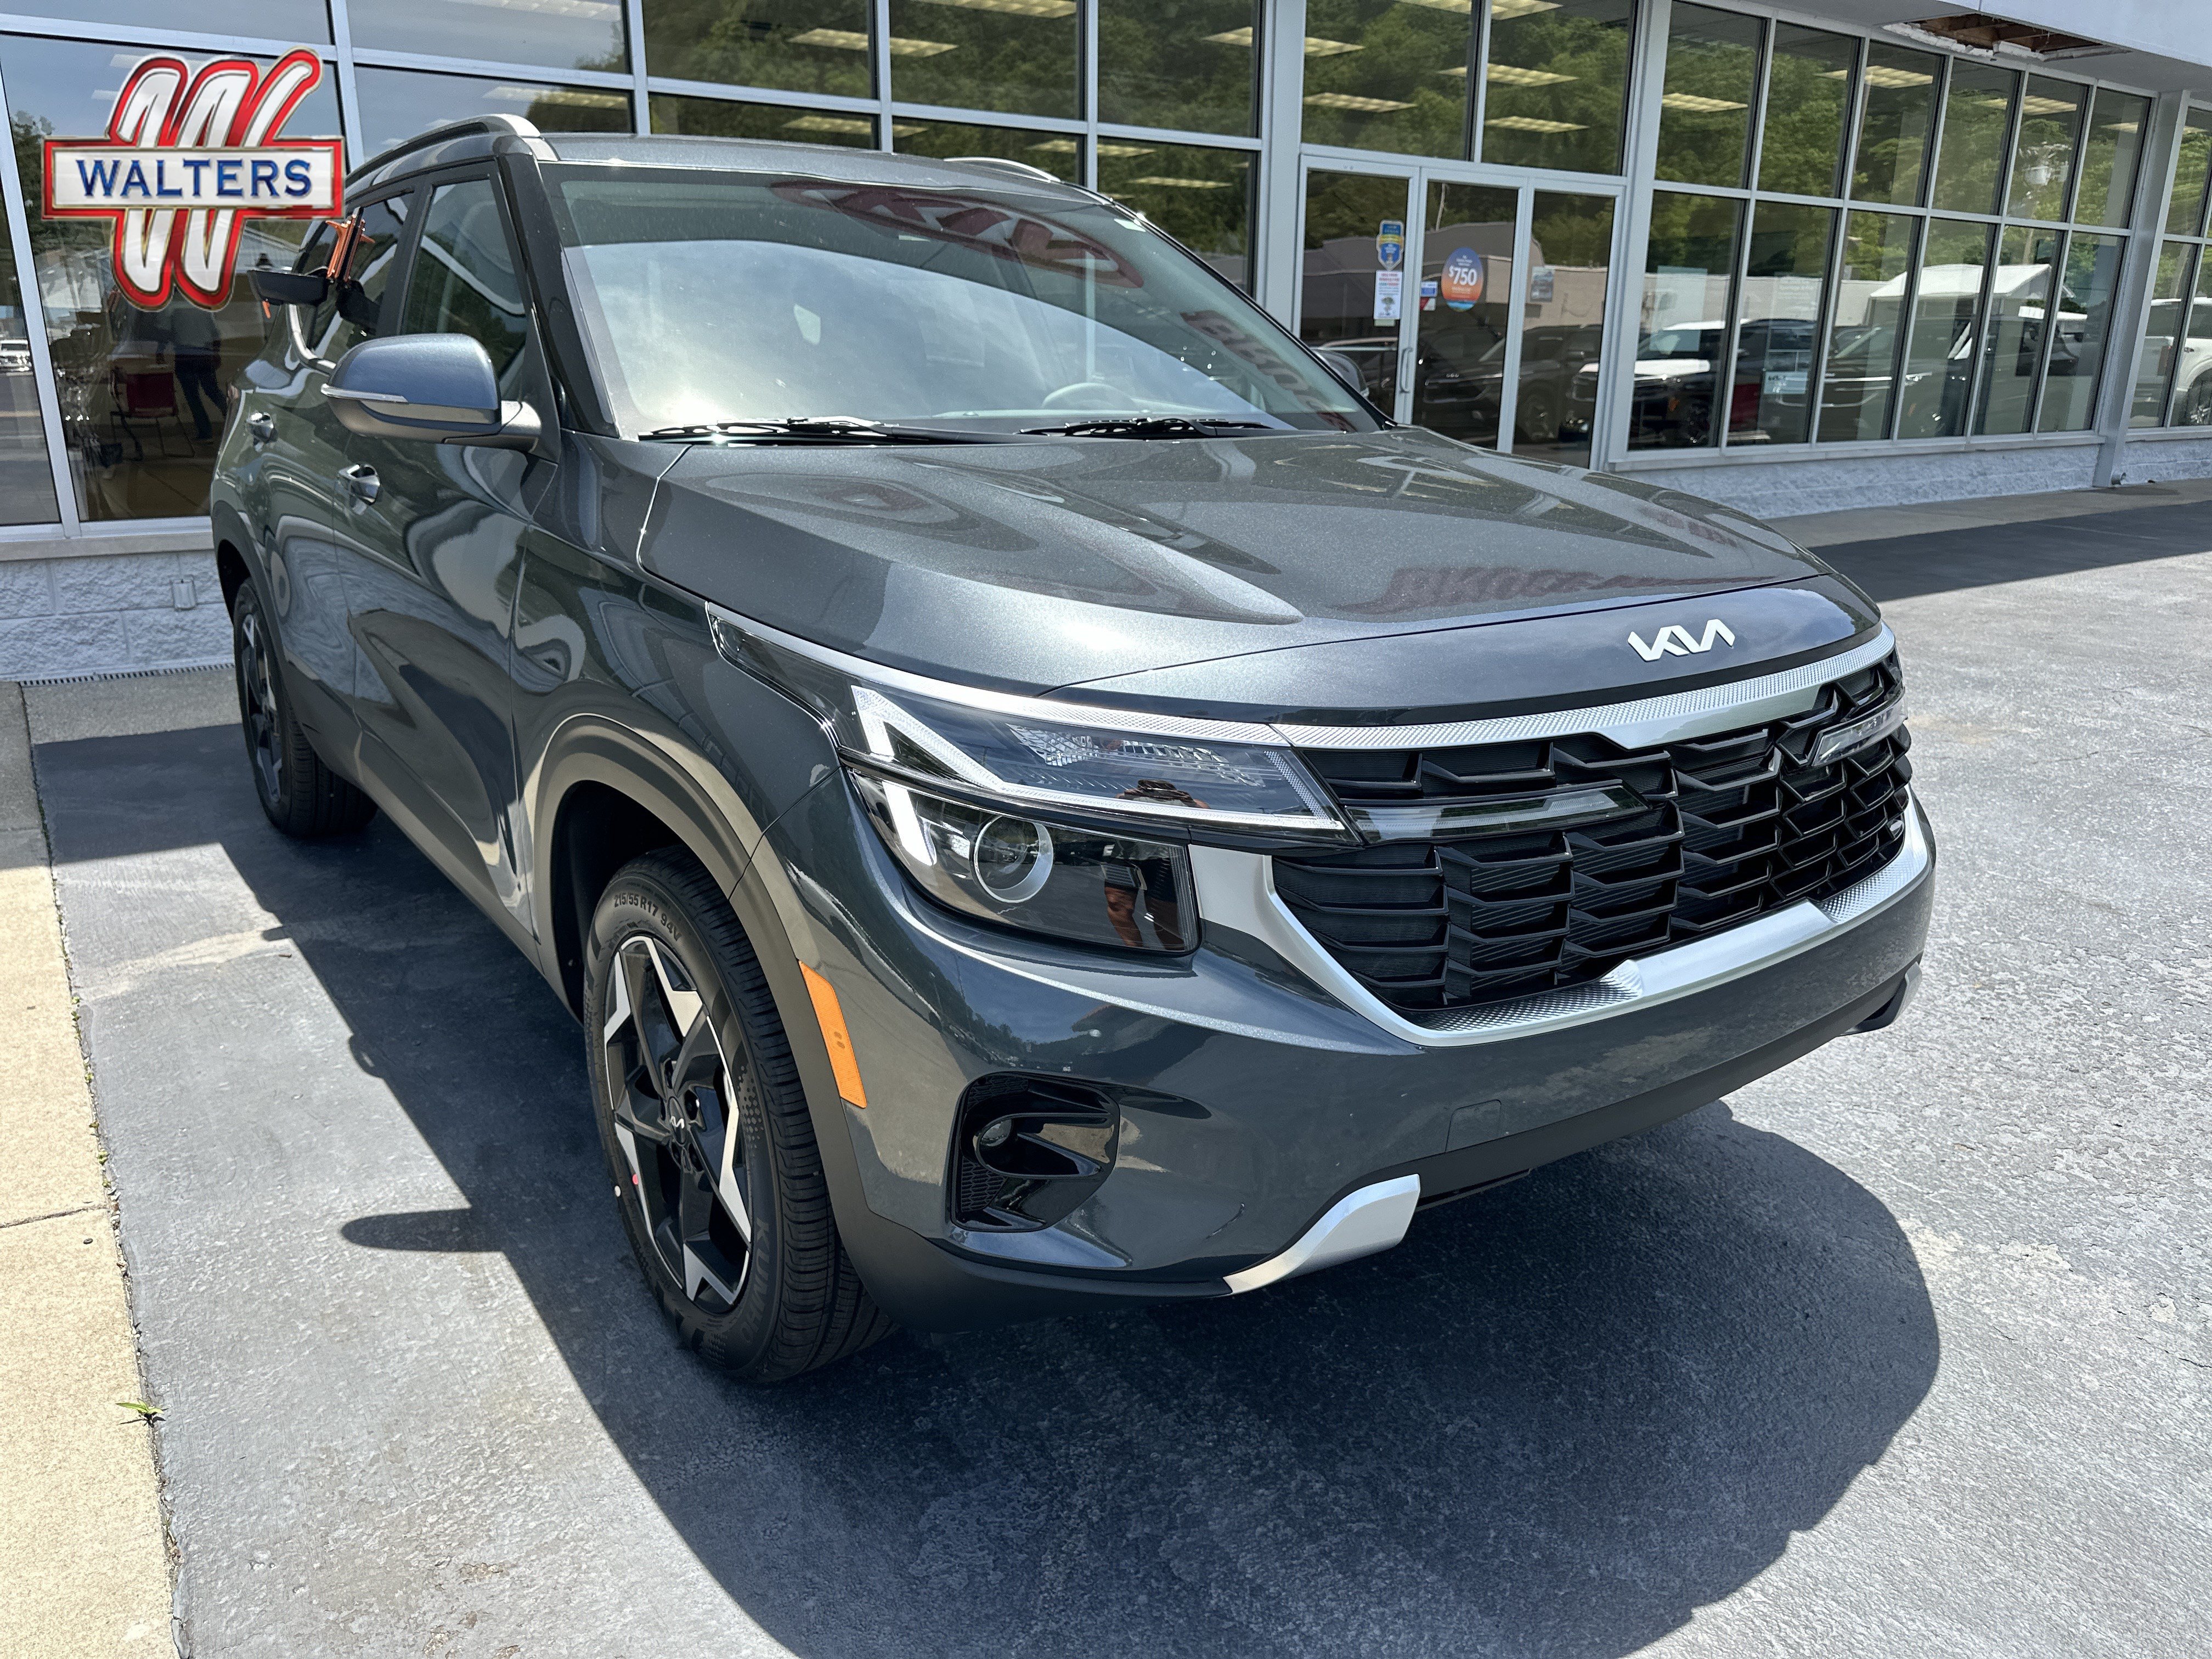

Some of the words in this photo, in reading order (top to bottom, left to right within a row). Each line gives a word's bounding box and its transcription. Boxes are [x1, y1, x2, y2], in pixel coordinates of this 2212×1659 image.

[1448, 265, 1477, 286] $750
[1627, 618, 1735, 662] KIA
[614, 892, 639, 908] 215/55
[640, 895, 659, 917] R17
[660, 913, 682, 941] 94V
[741, 1216, 770, 1344] KUMHO
